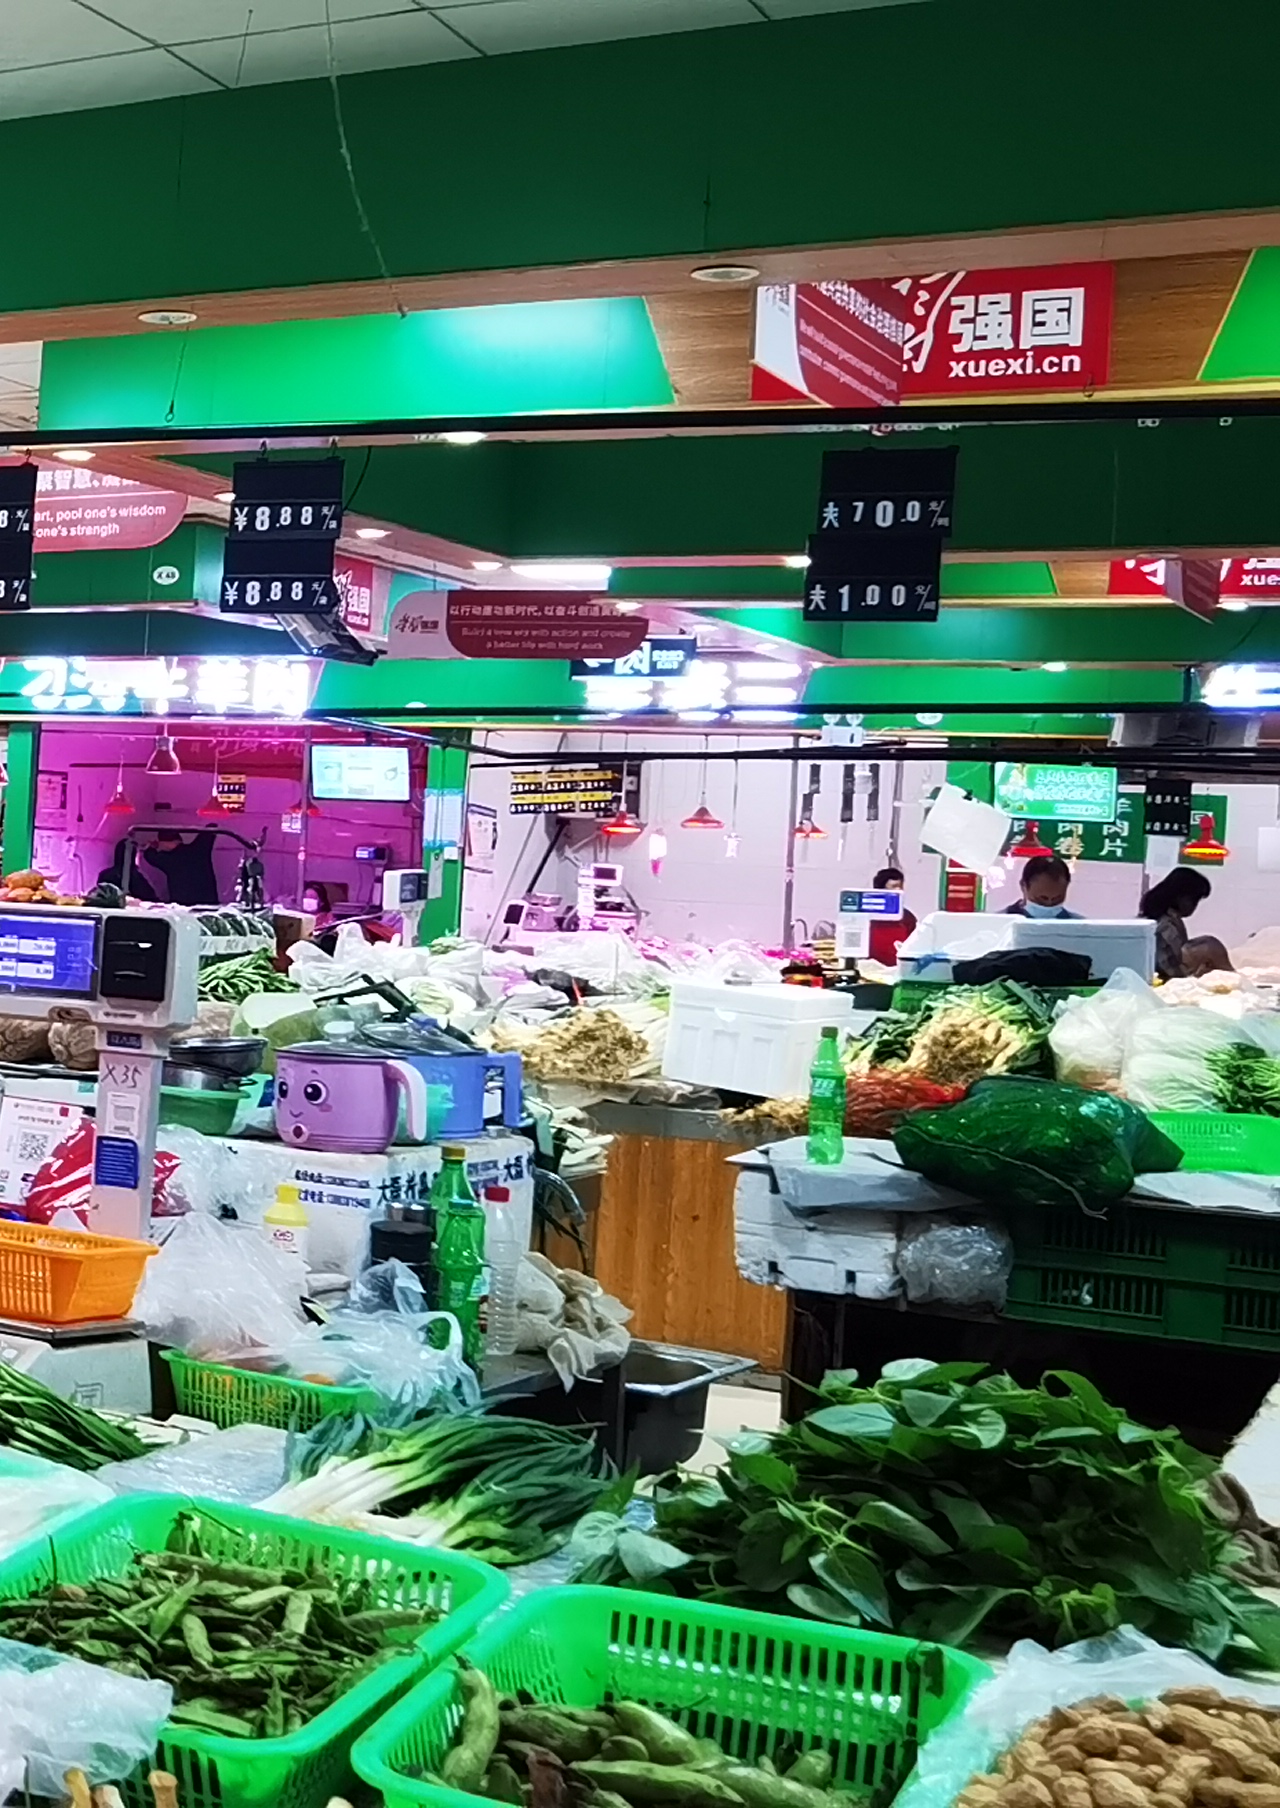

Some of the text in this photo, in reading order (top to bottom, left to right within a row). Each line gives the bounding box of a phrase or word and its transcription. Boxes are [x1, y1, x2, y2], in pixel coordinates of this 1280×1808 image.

[948, 352, 1082, 379] xuexi.cn
[56, 508, 83, 523] pool
[84, 506, 118, 519] one's
[118, 504, 167, 517] wisdom
[69, 522, 120, 538] strength
